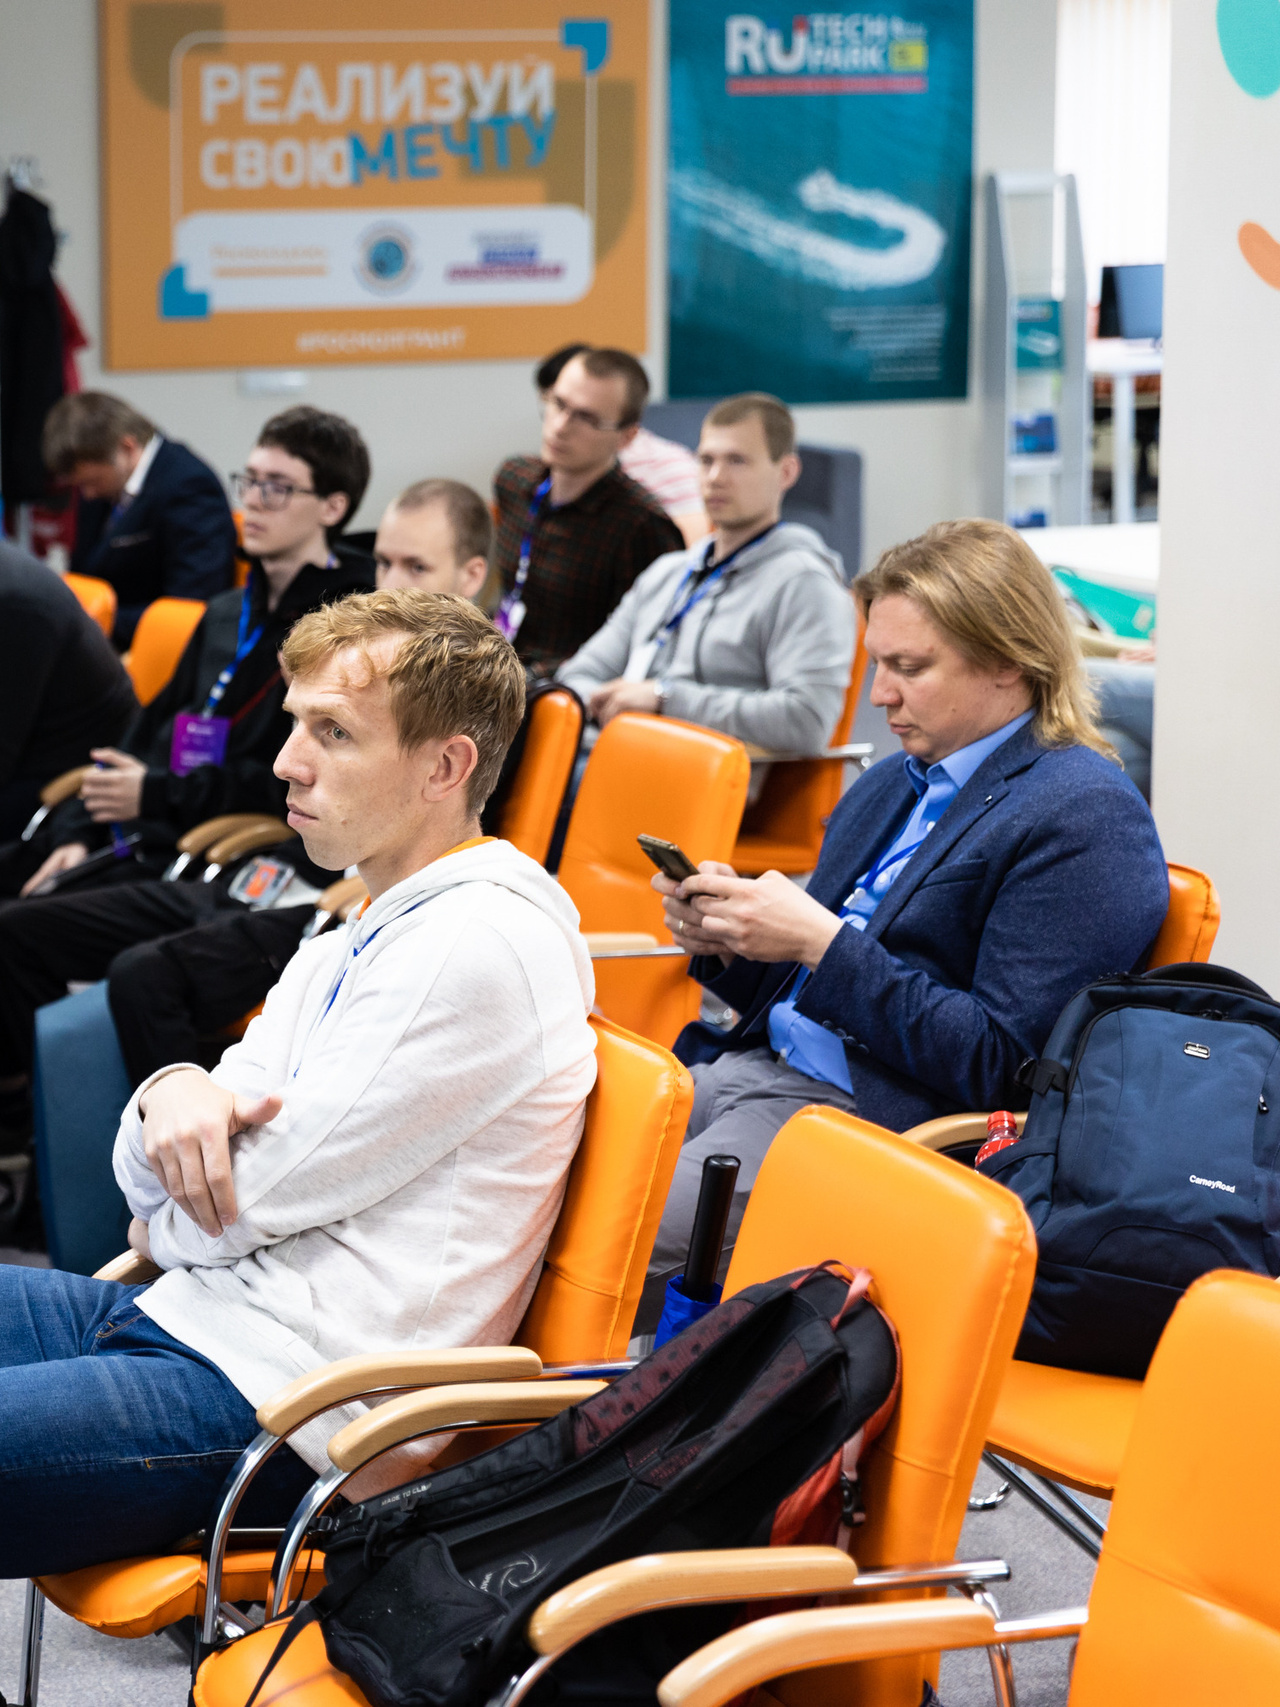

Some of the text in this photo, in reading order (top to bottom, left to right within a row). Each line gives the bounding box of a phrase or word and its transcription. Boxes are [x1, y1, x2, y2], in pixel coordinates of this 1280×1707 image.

[809, 13, 888, 44] TECH
[809, 47, 886, 72] PARK
[199, 56, 556, 124] РЕАЛИЗУЙ
[198, 108, 558, 191] СВОЮ МЕЧТУ
[1189, 1174, 1236, 1194] CarneyRoad
[381, 1494, 401, 1506] MADE
[402, 1490, 411, 1499] TO
